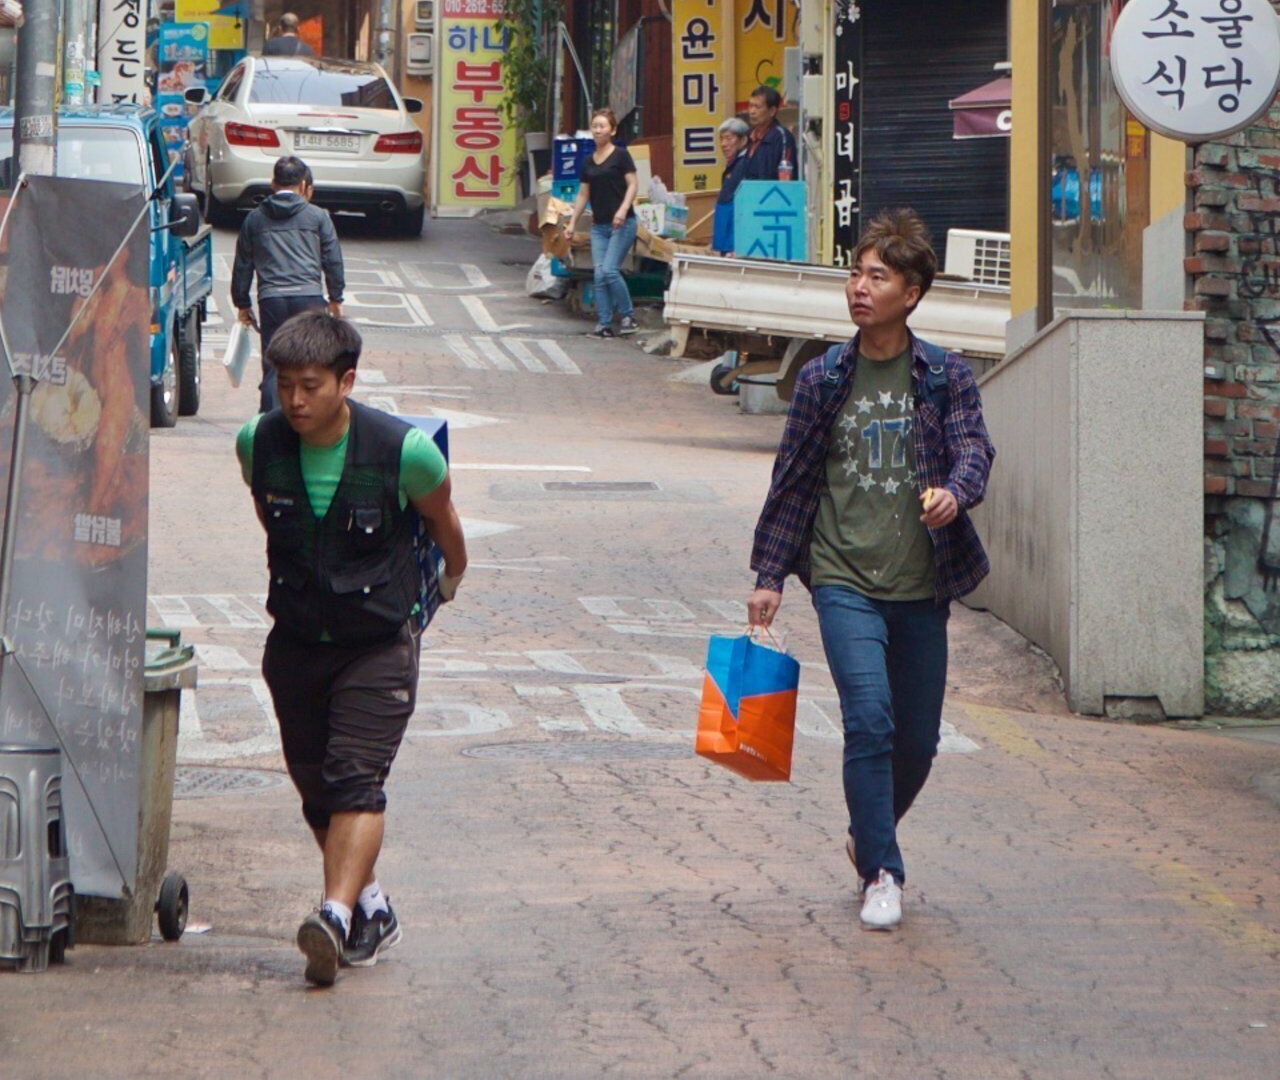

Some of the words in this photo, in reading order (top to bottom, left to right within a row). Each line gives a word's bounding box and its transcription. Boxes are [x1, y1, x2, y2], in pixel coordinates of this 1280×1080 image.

[1142, 55, 1254, 114] 식당
[452, 60, 505, 199] 부동산
[861, 417, 912, 468] 17
